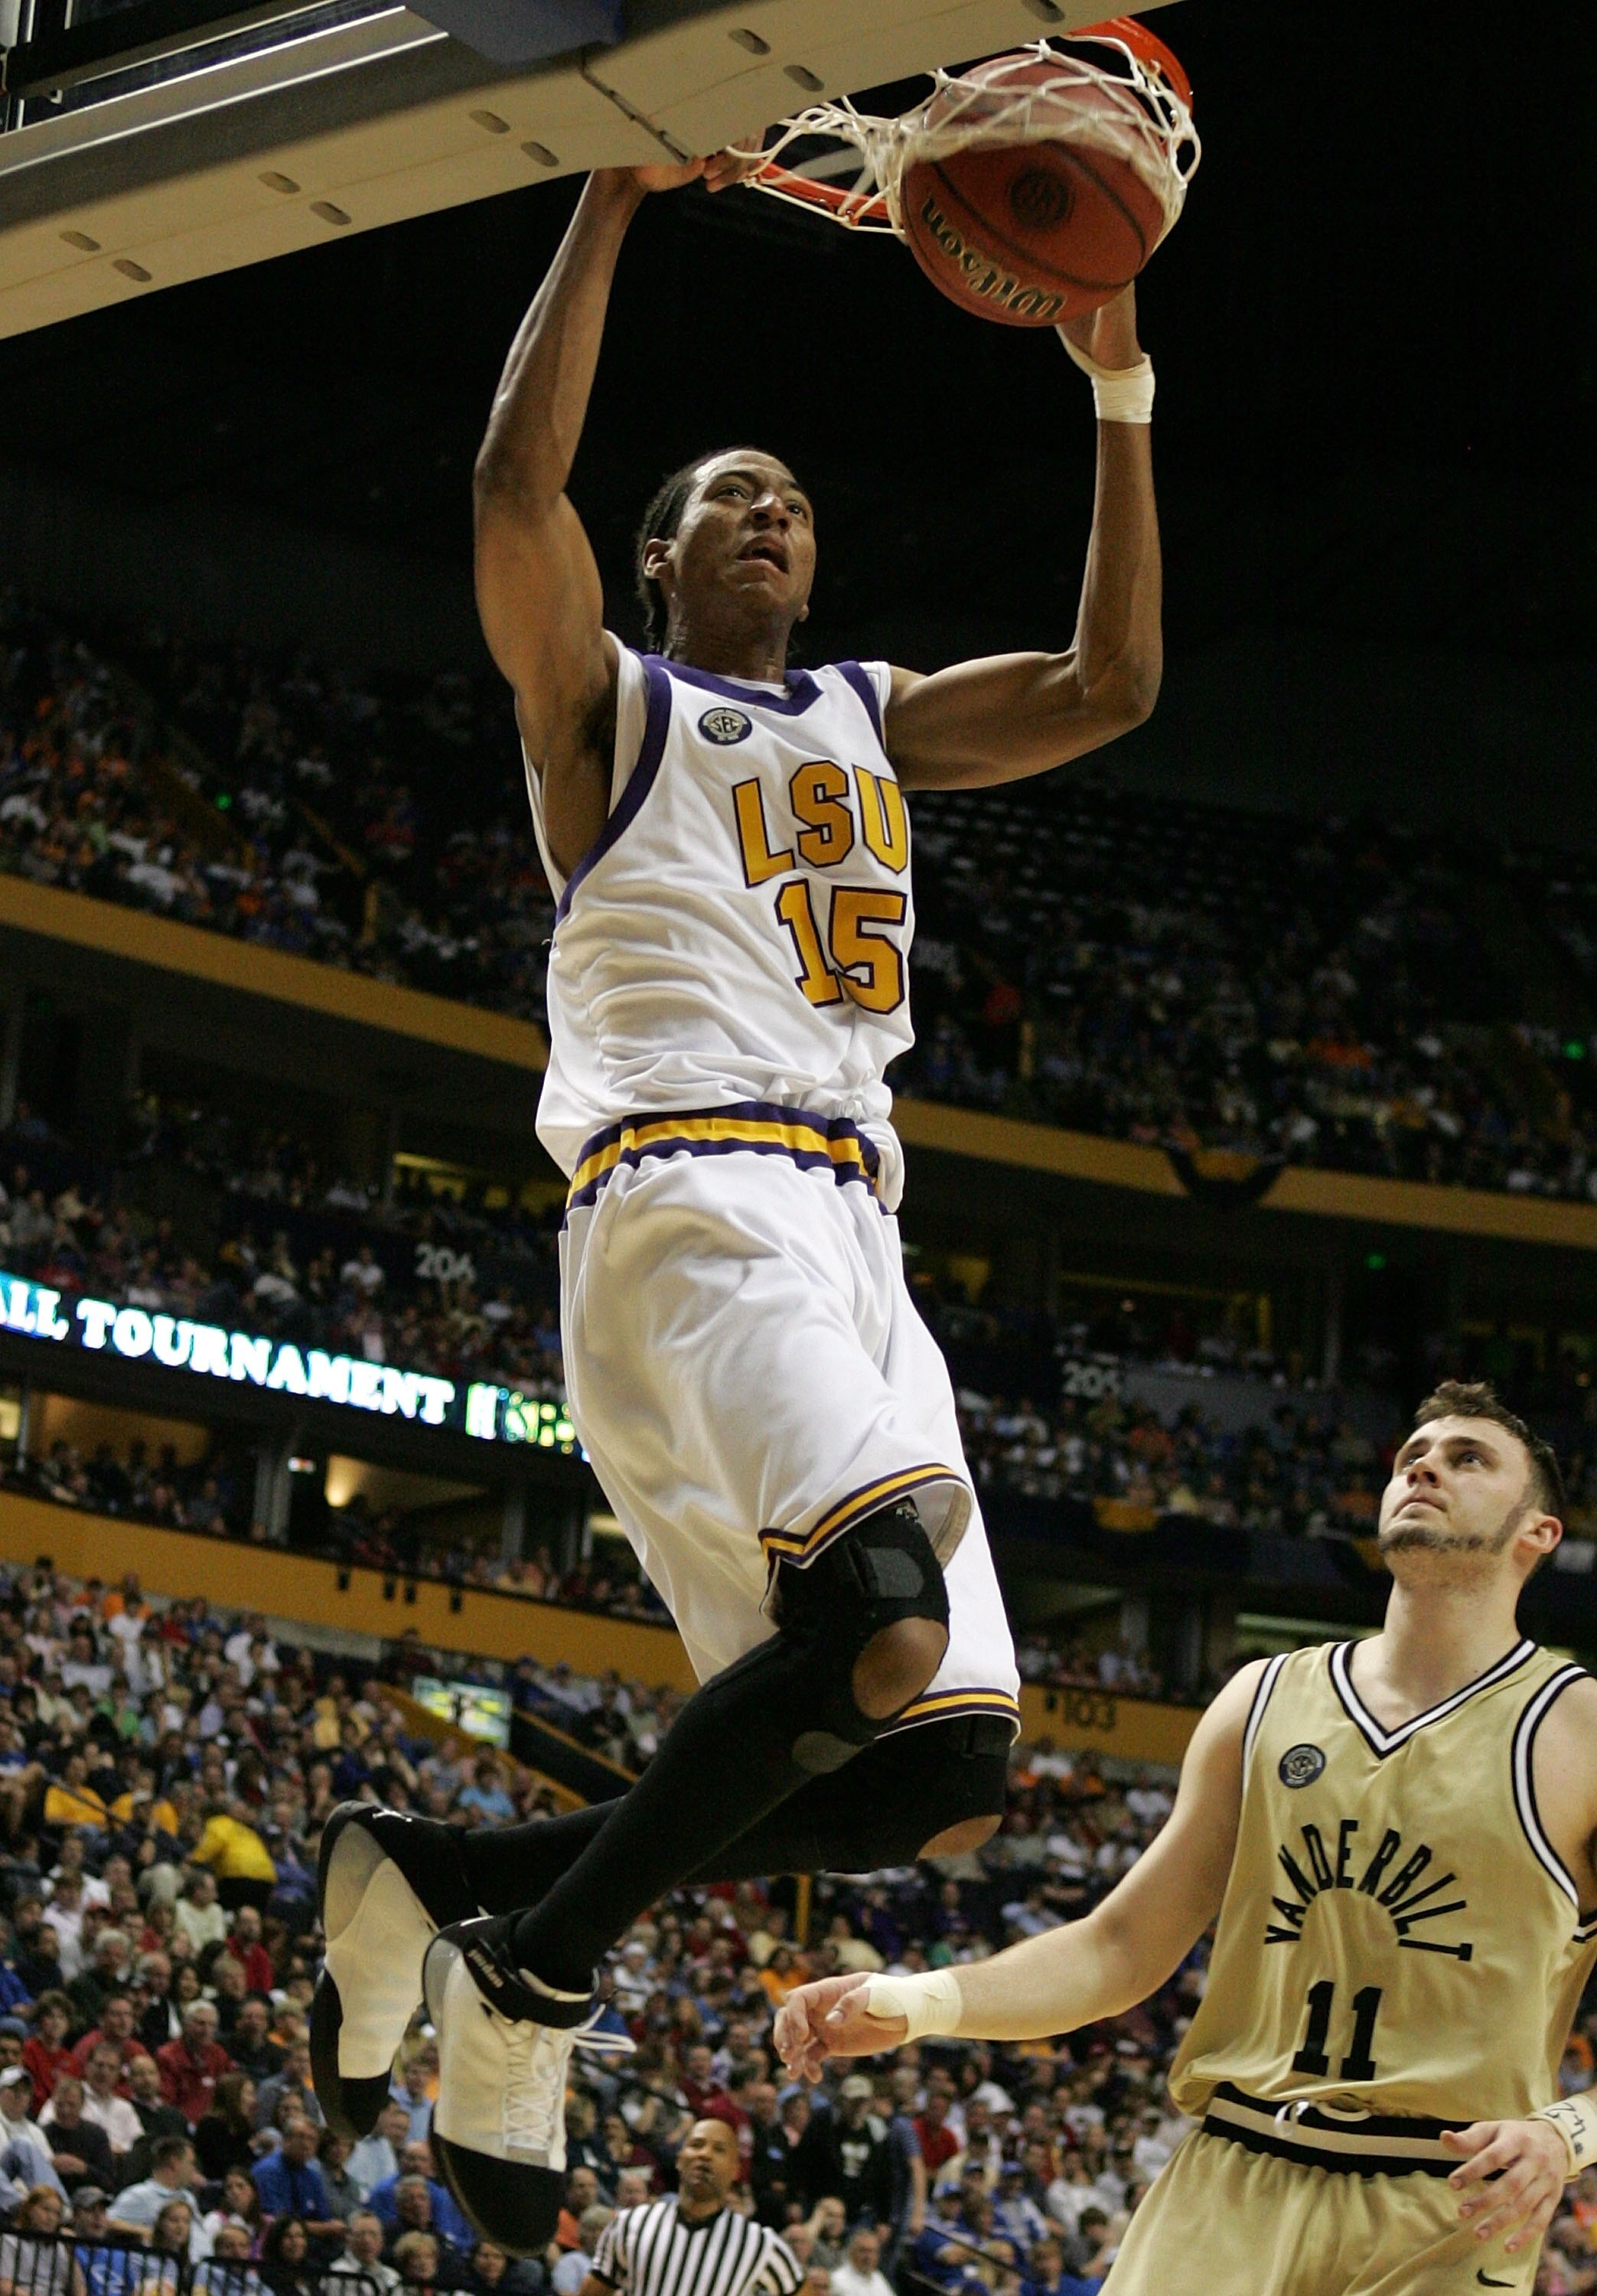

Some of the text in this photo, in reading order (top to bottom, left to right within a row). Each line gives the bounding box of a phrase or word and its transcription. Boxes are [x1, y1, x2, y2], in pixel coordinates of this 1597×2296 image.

[732, 760, 909, 889] LSU
[774, 878, 908, 1015] 15
[0, 1279, 70, 1341] LL
[77, 1298, 455, 1425] TOURNAMENT
[1264, 1819, 1473, 1962] VANDERBILT
[1292, 1981, 1382, 2081] 11
